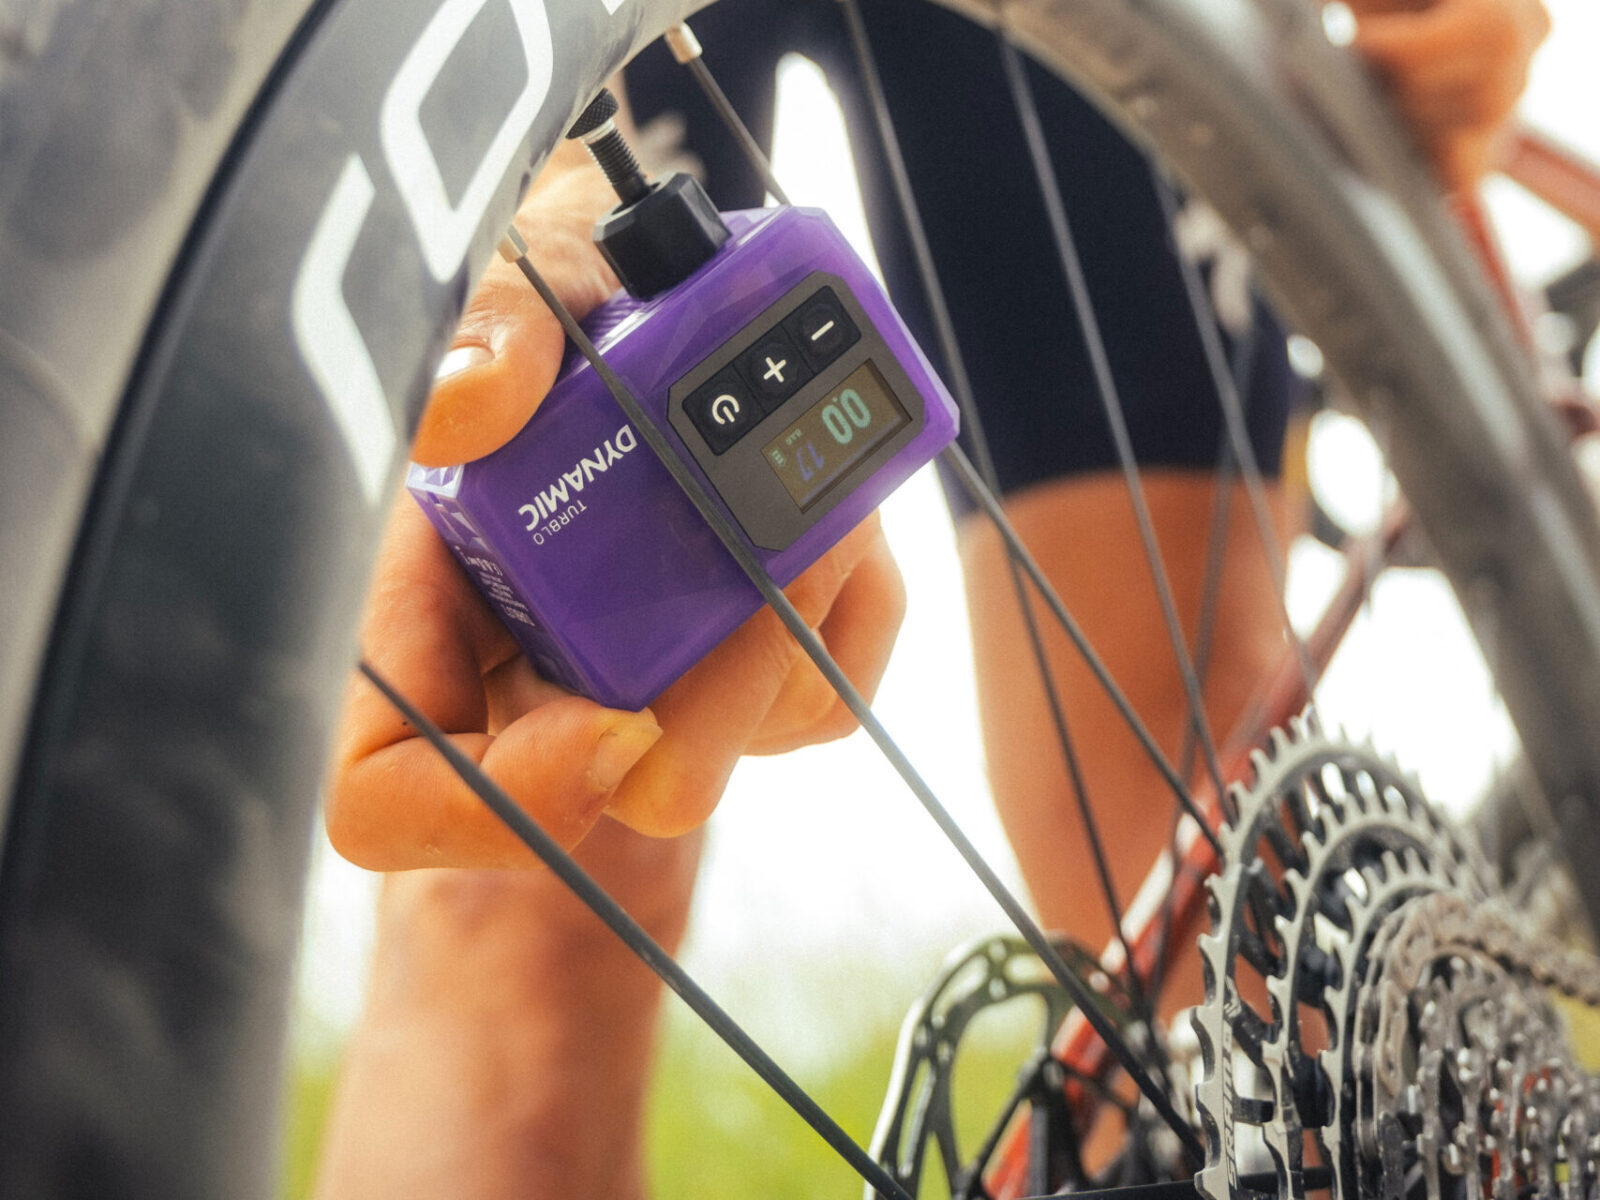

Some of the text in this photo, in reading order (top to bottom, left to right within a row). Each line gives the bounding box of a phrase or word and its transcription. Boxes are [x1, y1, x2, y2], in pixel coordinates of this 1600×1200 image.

[822, 389, 871, 444] 0.0
[517, 424, 639, 531] DYNAMIC
[533, 499, 587, 545] TURBLO
